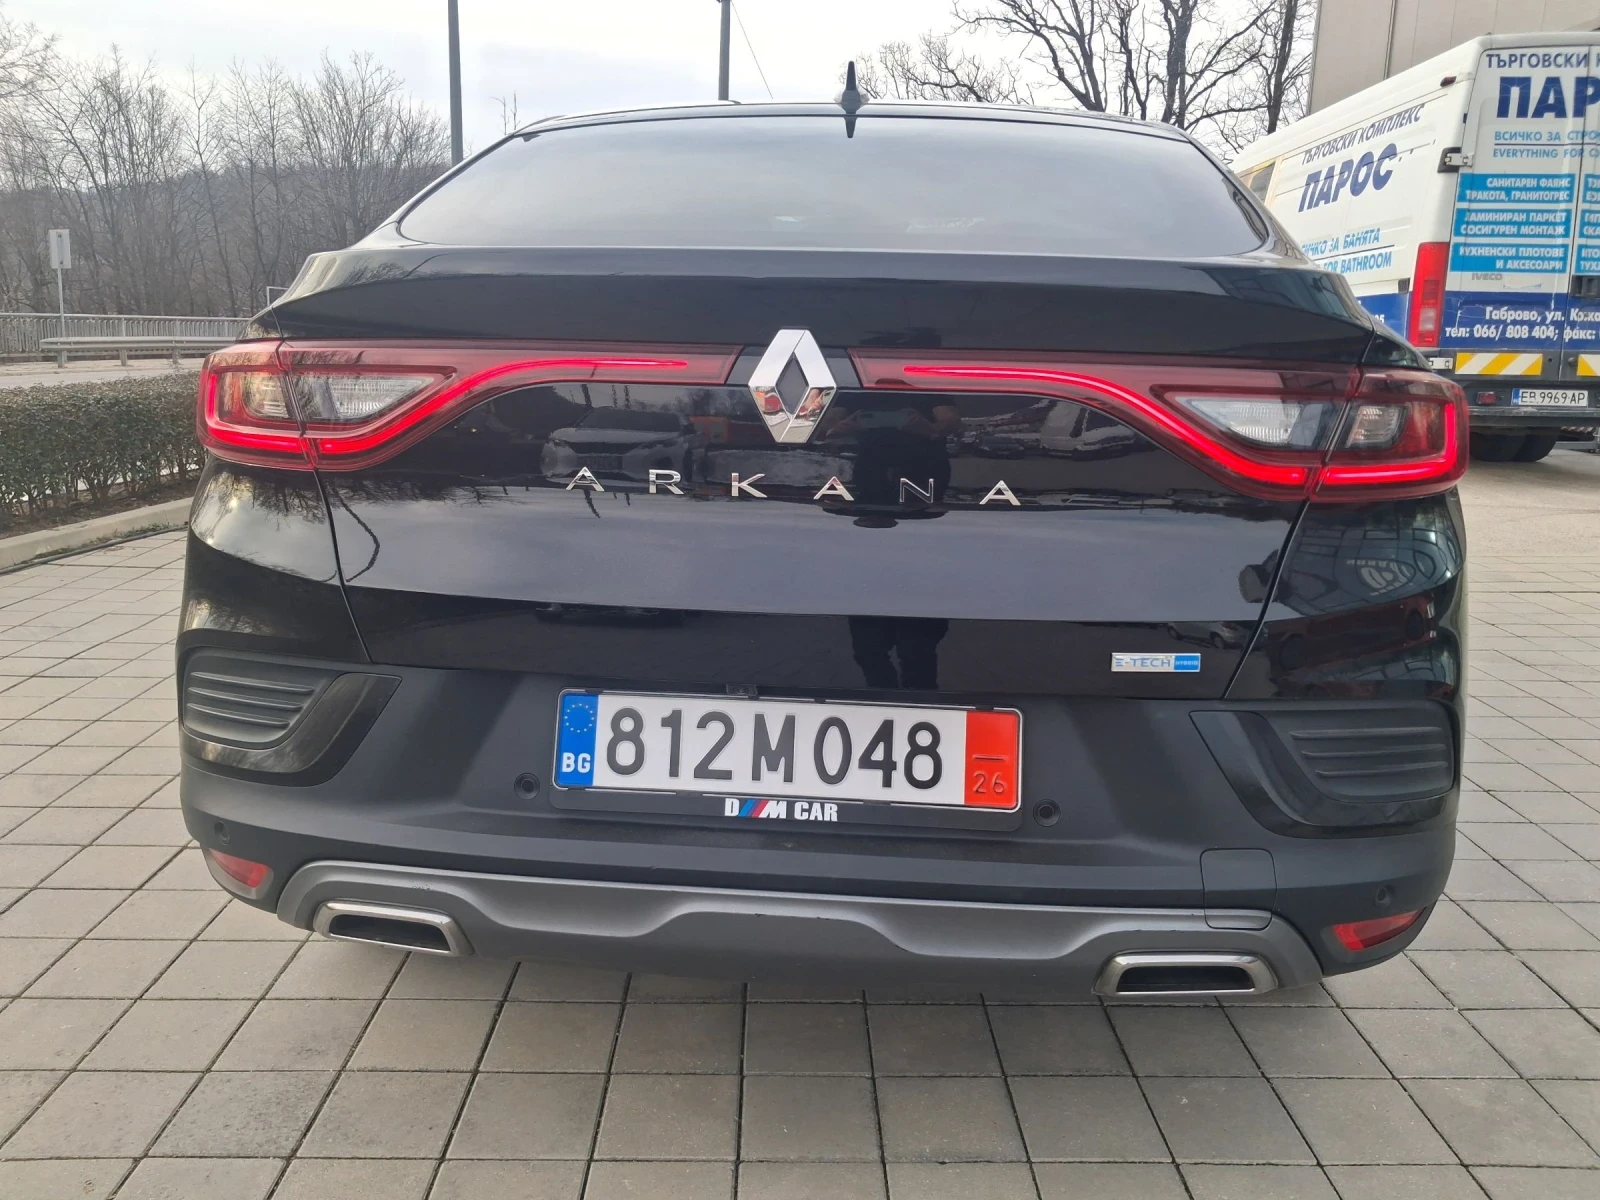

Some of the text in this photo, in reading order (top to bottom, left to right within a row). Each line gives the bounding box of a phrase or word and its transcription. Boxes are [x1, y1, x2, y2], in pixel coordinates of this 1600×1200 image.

[1486, 53, 1589, 69] ТЪРГОВСКИ
[1301, 103, 1425, 166] ТЪРГОВСКИ КОМПЛЕКС
[1494, 131, 1543, 141] ВСИЧКО
[1546, 131, 1561, 141] ЗА
[1493, 148, 1559, 159] EVERYTHING
[1298, 143, 1398, 213] ПАРОС
[1486, 178, 1571, 188] САНИТАРЕН ФАЯНС
[1466, 191, 1570, 202] ТРАКОТА, ГРАНИТОГРЕС
[1529, 213, 1567, 223] ПАРКЕТ
[1343, 227, 1380, 249] БАНЯТА
[1520, 225, 1565, 235] МОНТАЖ
[1460, 247, 1564, 257] КУХНЕНСКИ ПЛОТОВЕ
[1340, 251, 1392, 274] BATHROOM
[1496, 260, 1563, 270] И АКСЕСОАРИ
[1471, 272, 1503, 281] IVECO
[1485, 306, 1541, 323] Габрово,
[1545, 311, 1565, 324] ул.
[1445, 325, 1596, 343] тел: 066/ 808 404; факс:
[565, 466, 1022, 506] ARKANA
[1114, 657, 1171, 668] E-TECH
[561, 753, 592, 773] BG
[973, 771, 1006, 795] 26
[794, 802, 838, 822] CAR
